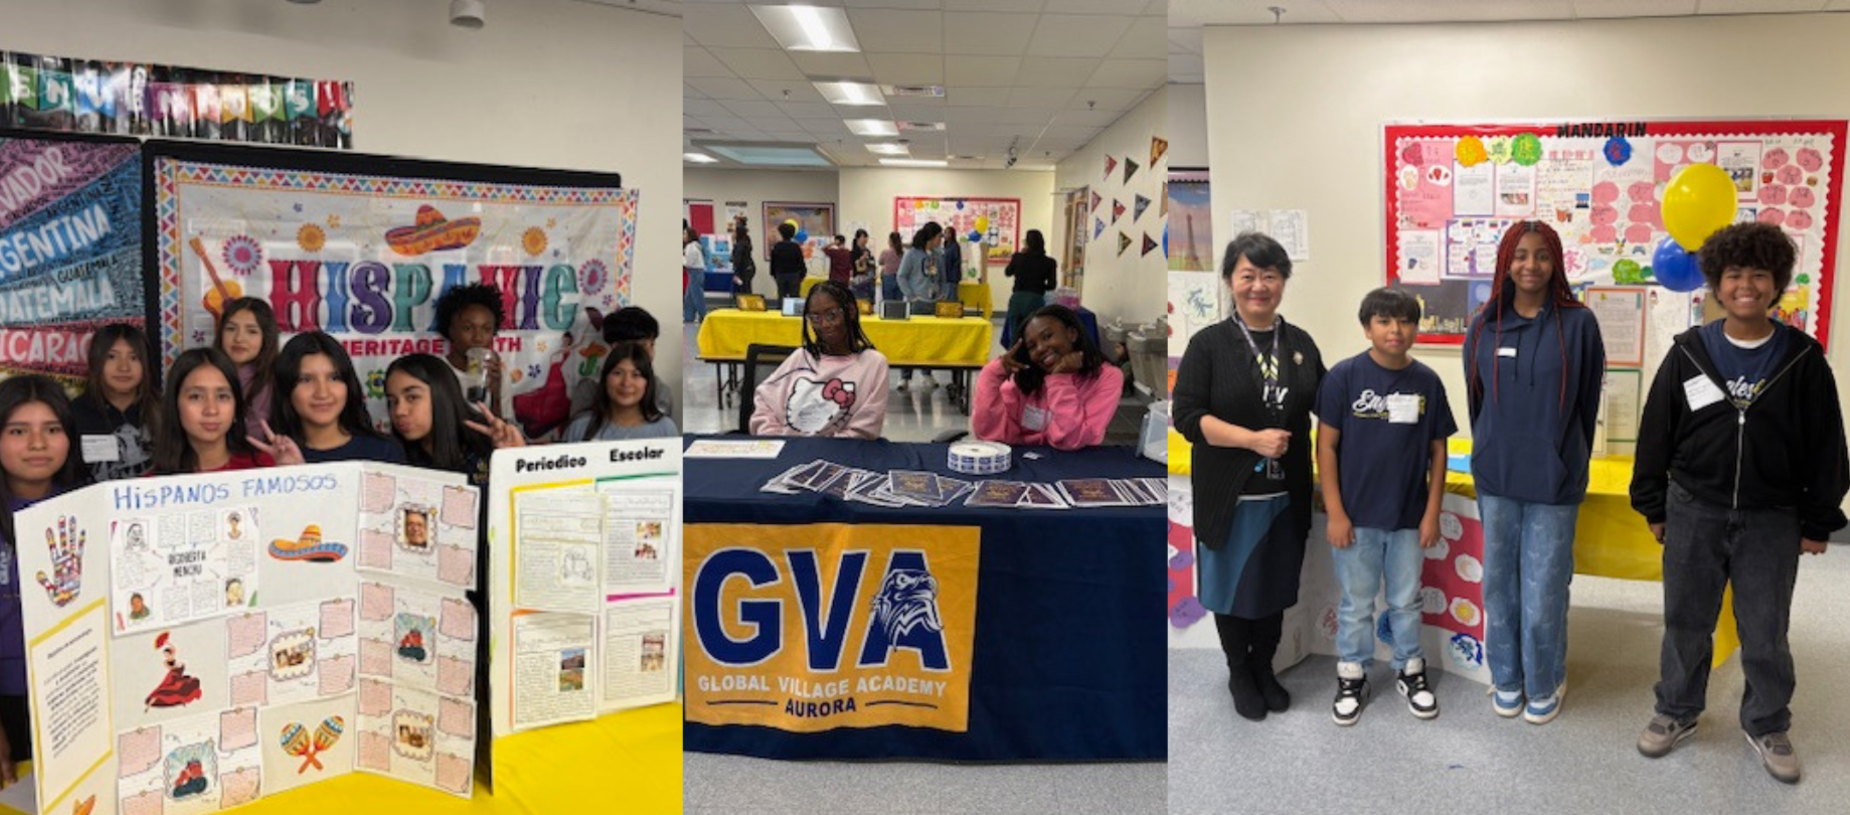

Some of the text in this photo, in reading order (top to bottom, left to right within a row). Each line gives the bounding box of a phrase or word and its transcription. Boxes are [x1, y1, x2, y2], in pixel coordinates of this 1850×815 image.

[1557, 122, 1646, 138] MANDARIN
[0, 146, 72, 220] VADOR
[0, 204, 111, 272] GENTINA
[515, 446, 665, 473] Periodico Escolar
[242, 474, 338, 497] FAMOSOS
[692, 548, 950, 673] GVA
[698, 675, 948, 699] GLOBAL VILLAGE ACADEMY
[785, 697, 857, 718] AURORA
